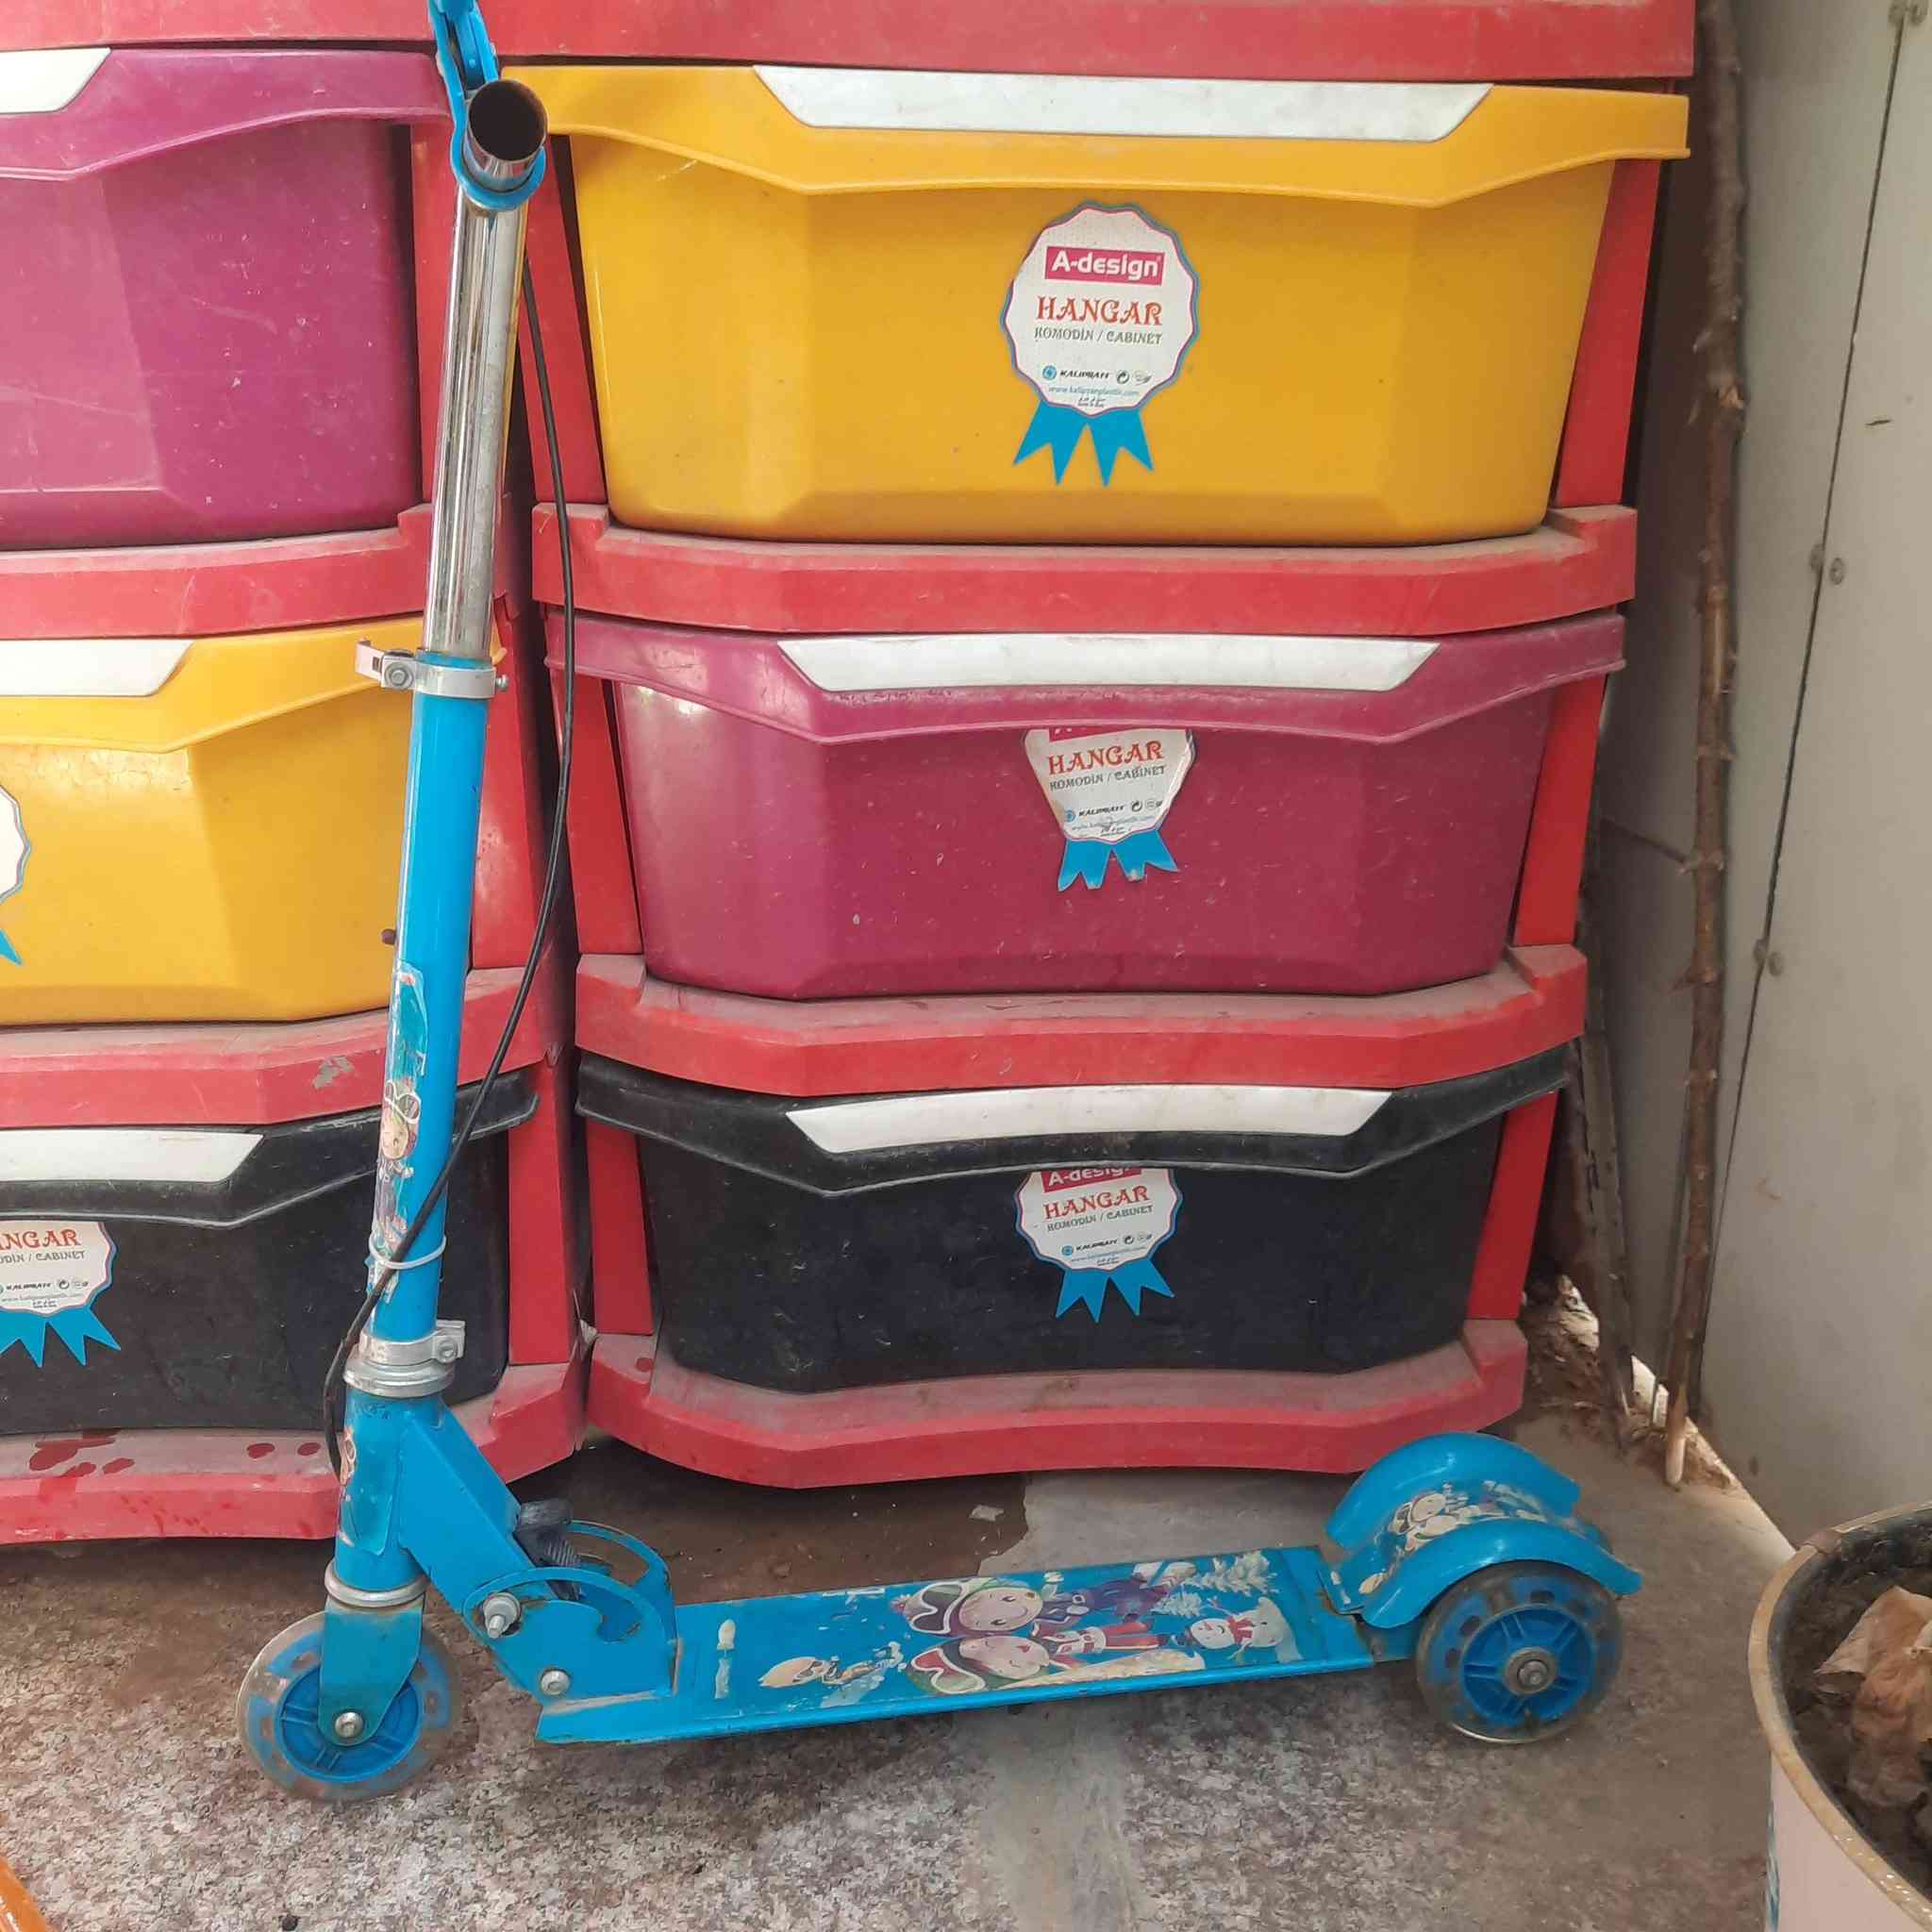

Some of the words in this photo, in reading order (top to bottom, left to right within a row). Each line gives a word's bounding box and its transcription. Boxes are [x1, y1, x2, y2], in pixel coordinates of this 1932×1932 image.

[1051, 250, 1158, 281] A-design
[1036, 295, 1163, 326] HANGAR
[1106, 330, 1163, 345] CABINET
[1048, 740, 1163, 775] HANGAR
[1114, 764, 1167, 781] CABINET
[1048, 1167, 1131, 1187] A-desig
[1043, 1185, 1151, 1220] HANGAR
[1106, 1204, 1154, 1220] CABINET
[0, 1228, 82, 1250] NGAR
[35, 1250, 86, 1261] CABINET
